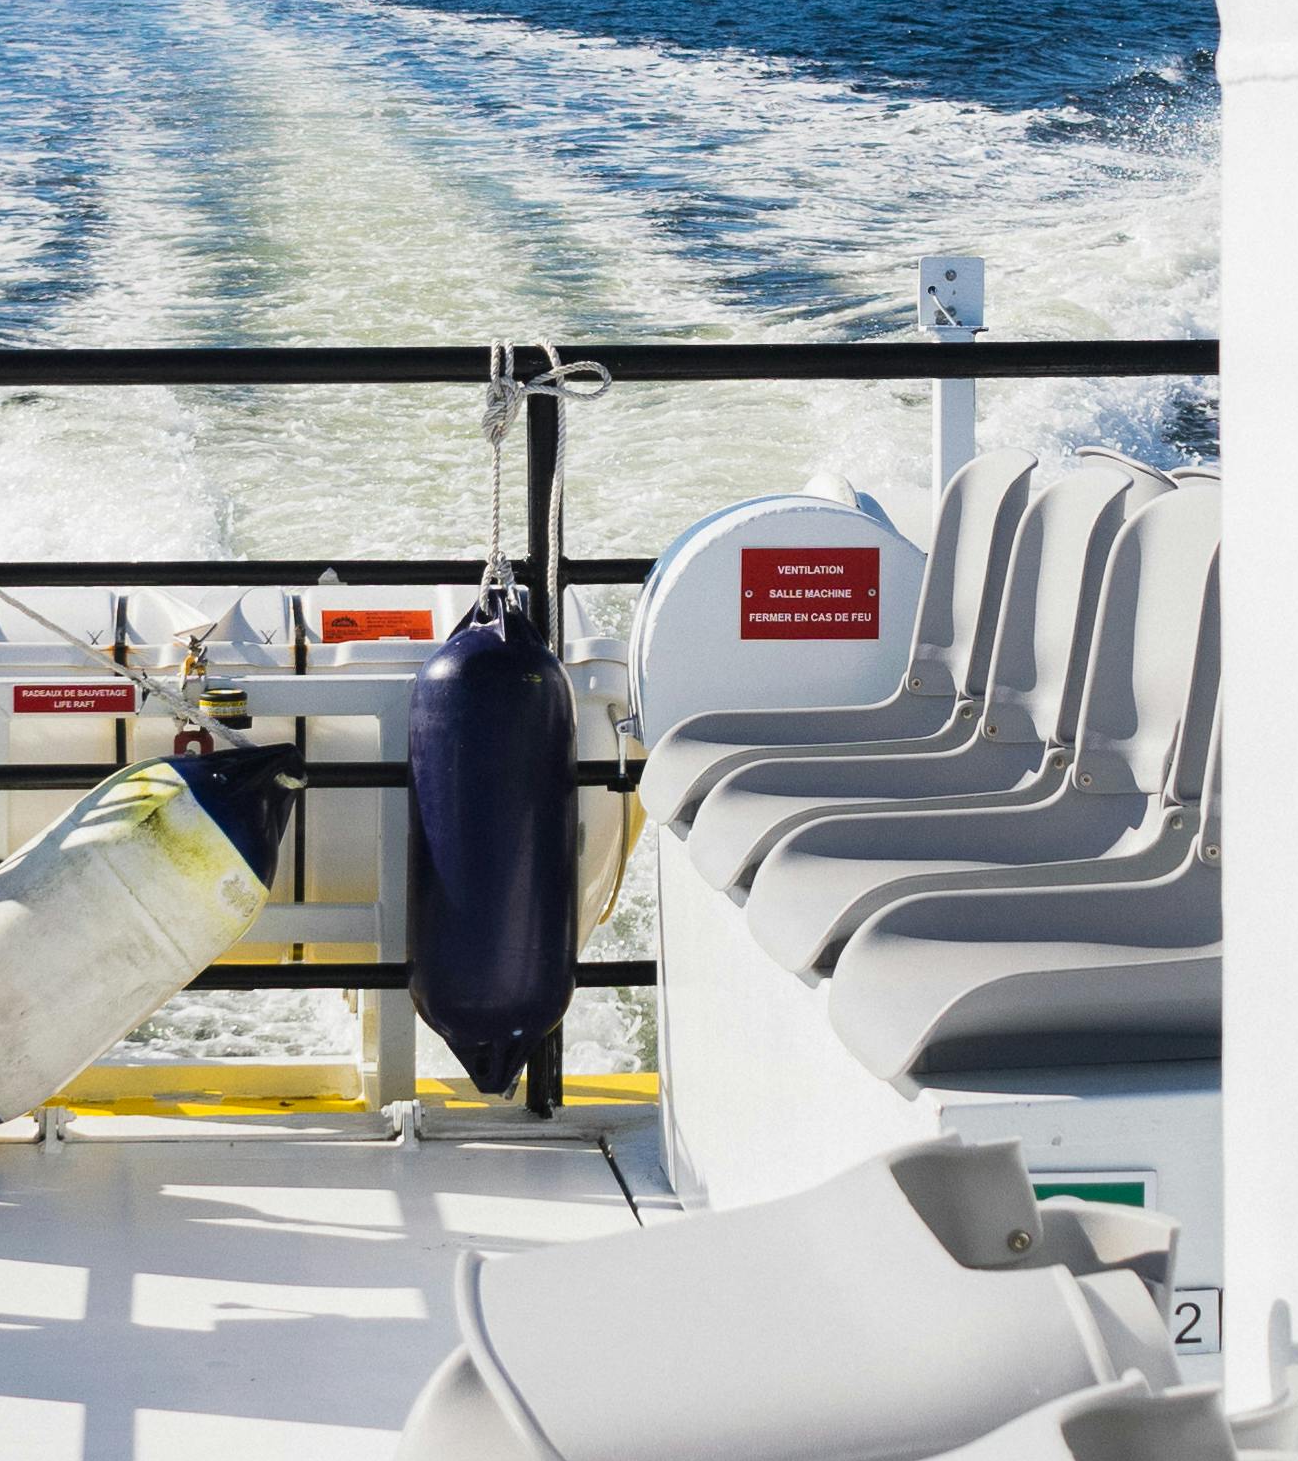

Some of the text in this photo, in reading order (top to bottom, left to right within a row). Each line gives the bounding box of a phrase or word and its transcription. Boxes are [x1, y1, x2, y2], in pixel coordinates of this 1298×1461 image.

[777, 565, 845, 576] VENTILATION
[768, 589, 853, 599] SALLE MACHINE
[748, 612, 872, 623] FERMER EN CAS DE FEU
[22, 689, 128, 698] RADEAUX DE SAUVETAGE
[53, 700, 96, 709] LIFE RAFT
[1174, 1301, 1203, 1345] 2
